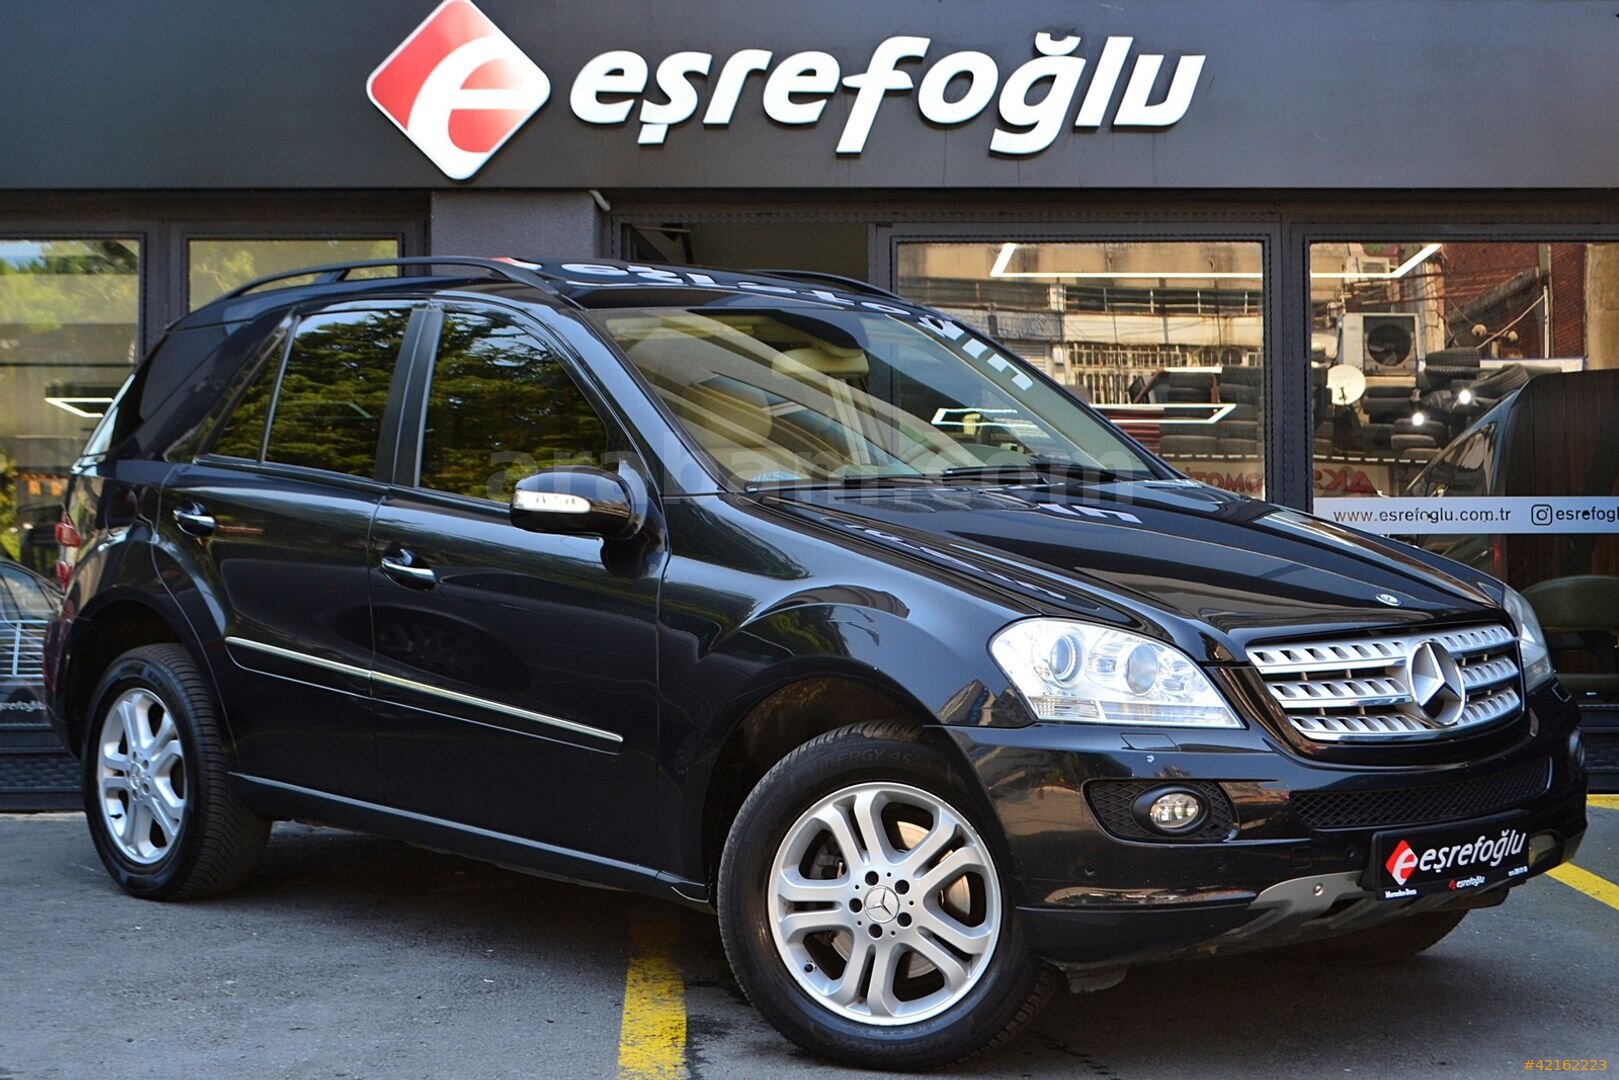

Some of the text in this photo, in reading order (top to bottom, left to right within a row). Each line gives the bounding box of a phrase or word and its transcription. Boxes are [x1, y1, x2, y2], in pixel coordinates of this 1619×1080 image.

[570, 31, 1206, 156] eşrefoğlu
[1334, 507, 1512, 524] www.esrefoglu.com.tr
[1419, 829, 1527, 872] eşrefoğlu
